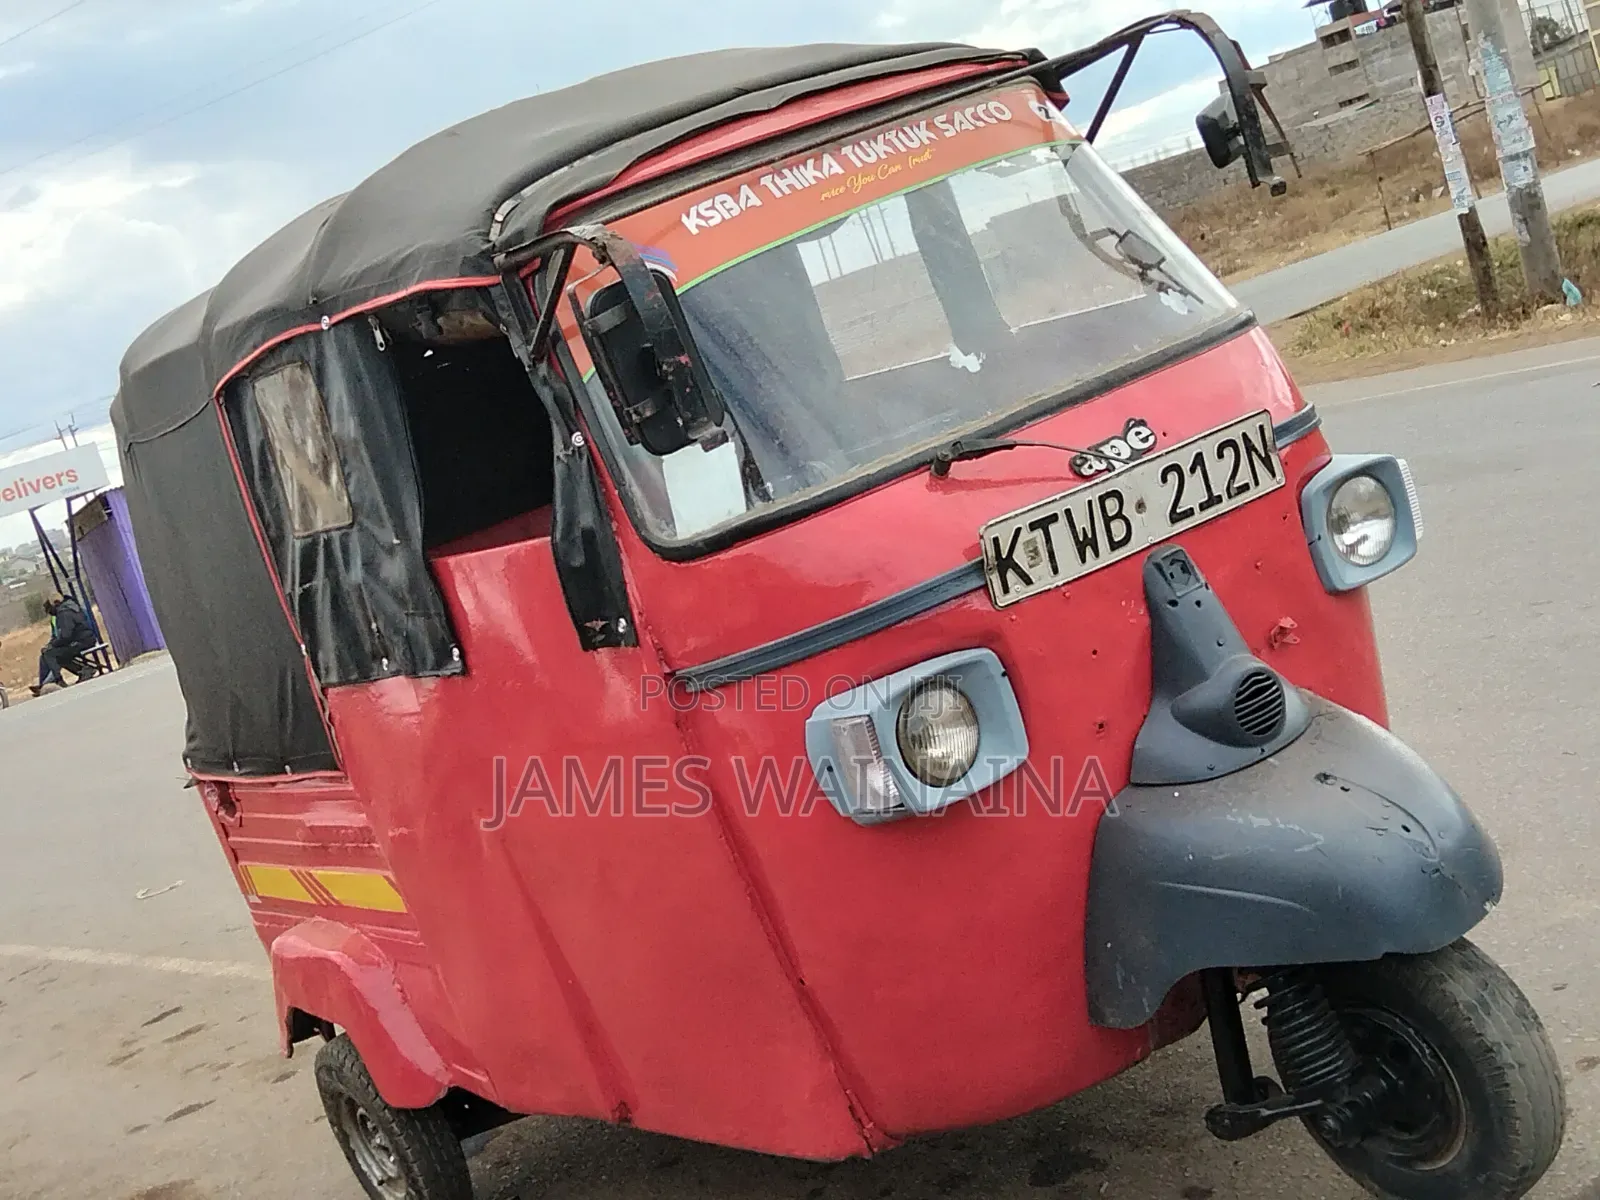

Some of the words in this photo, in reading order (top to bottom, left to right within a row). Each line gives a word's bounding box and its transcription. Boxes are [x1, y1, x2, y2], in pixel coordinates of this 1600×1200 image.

[681, 184, 763, 235] KSBA
[760, 152, 845, 198] THIKA
[841, 120, 938, 168] TUKTUK
[933, 101, 1012, 138] SACCO
[846, 172, 876, 194] You
[877, 163, 902, 180] Can
[0, 467, 79, 502] elivers
[992, 488, 1132, 595] KTWB
[1160, 423, 1277, 526] 212N
